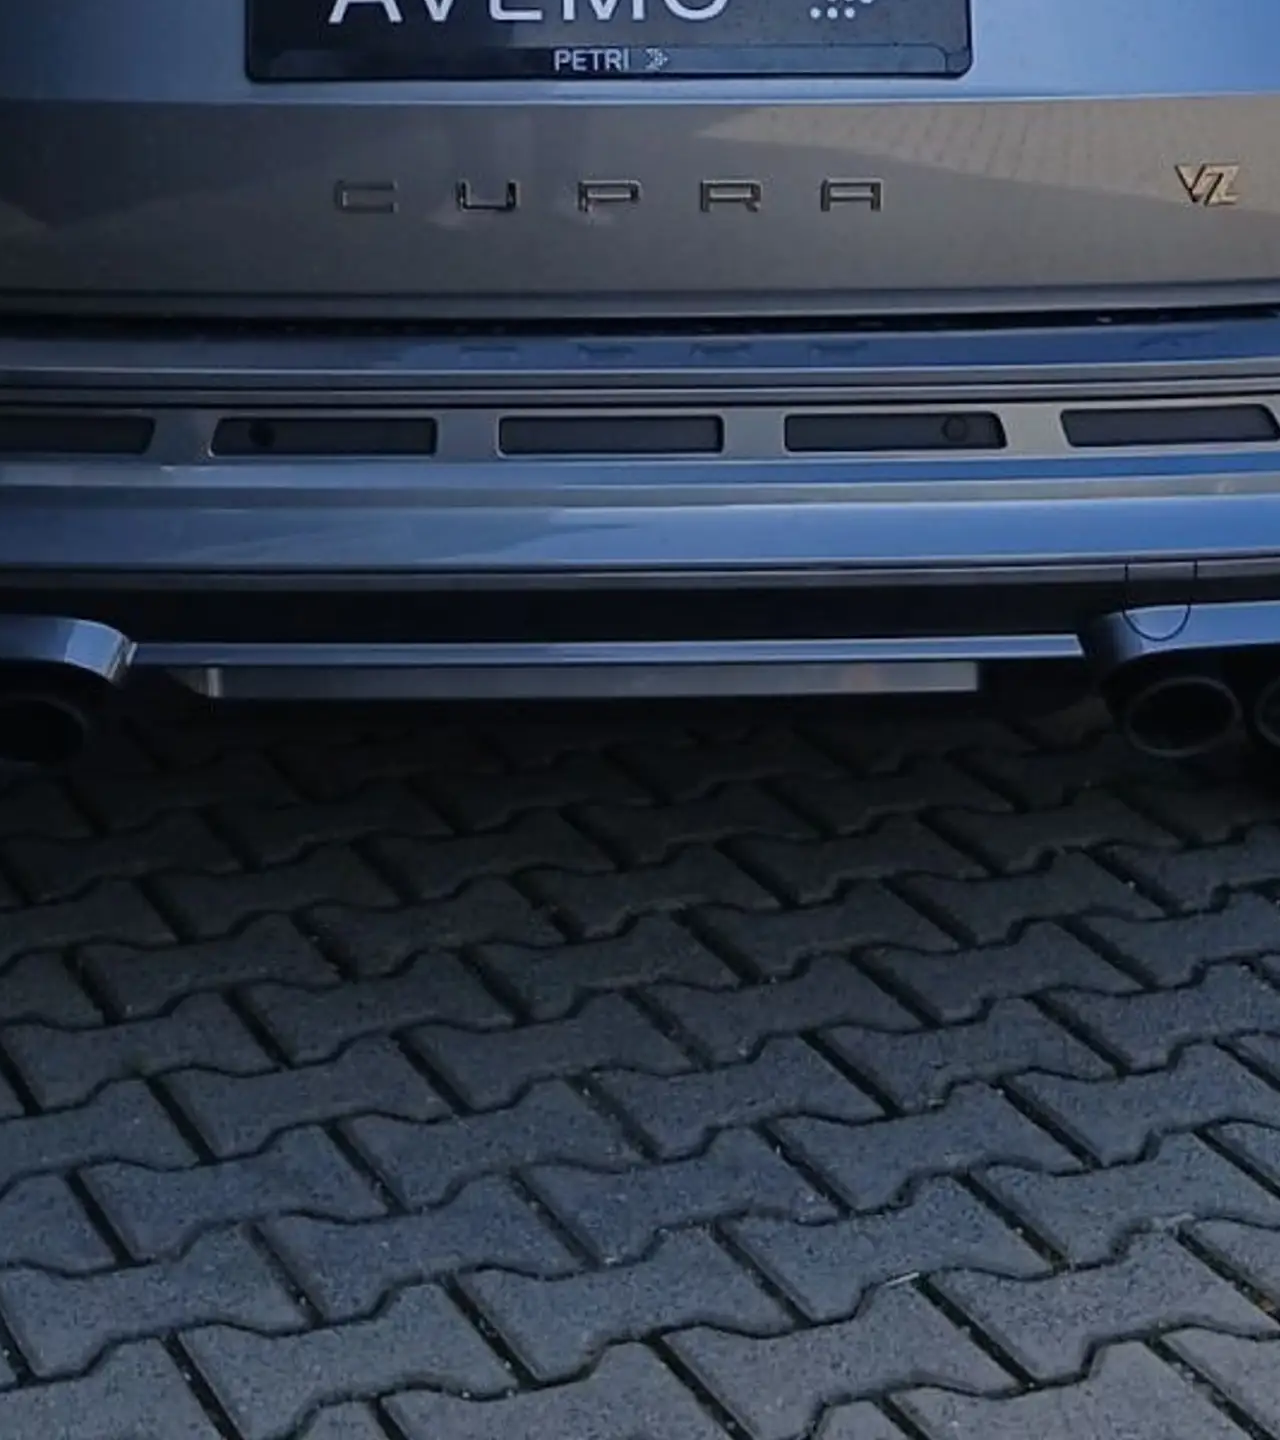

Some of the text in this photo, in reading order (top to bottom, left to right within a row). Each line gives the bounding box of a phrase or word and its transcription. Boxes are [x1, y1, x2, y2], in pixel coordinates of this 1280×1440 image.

[553, 48, 631, 72] PETRI
[333, 178, 885, 214] CUPRA
[1174, 162, 1241, 207] VZ
